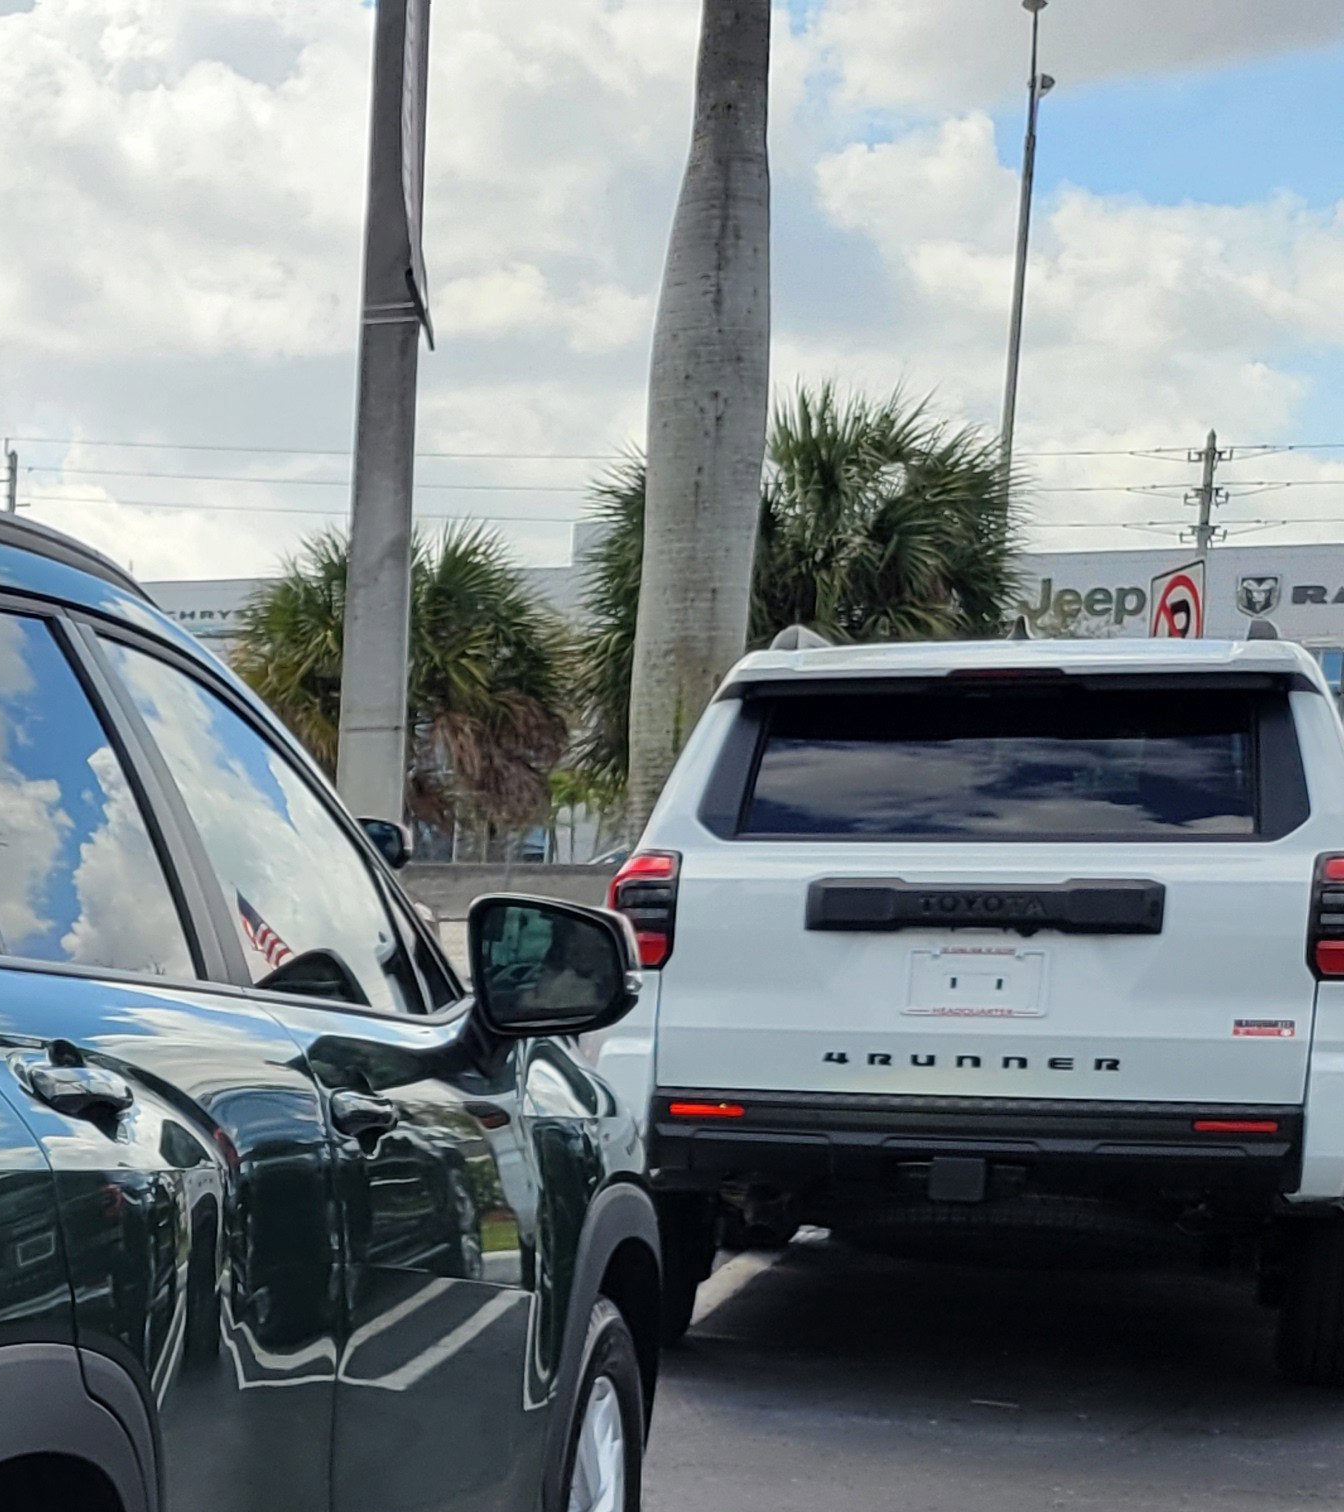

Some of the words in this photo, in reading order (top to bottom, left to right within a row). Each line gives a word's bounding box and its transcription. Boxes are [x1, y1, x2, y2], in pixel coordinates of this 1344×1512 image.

[1018, 578, 1147, 625] Jeep
[919, 895, 1047, 916] TOYOTA
[822, 1052, 1121, 1071] 4RUNNER
